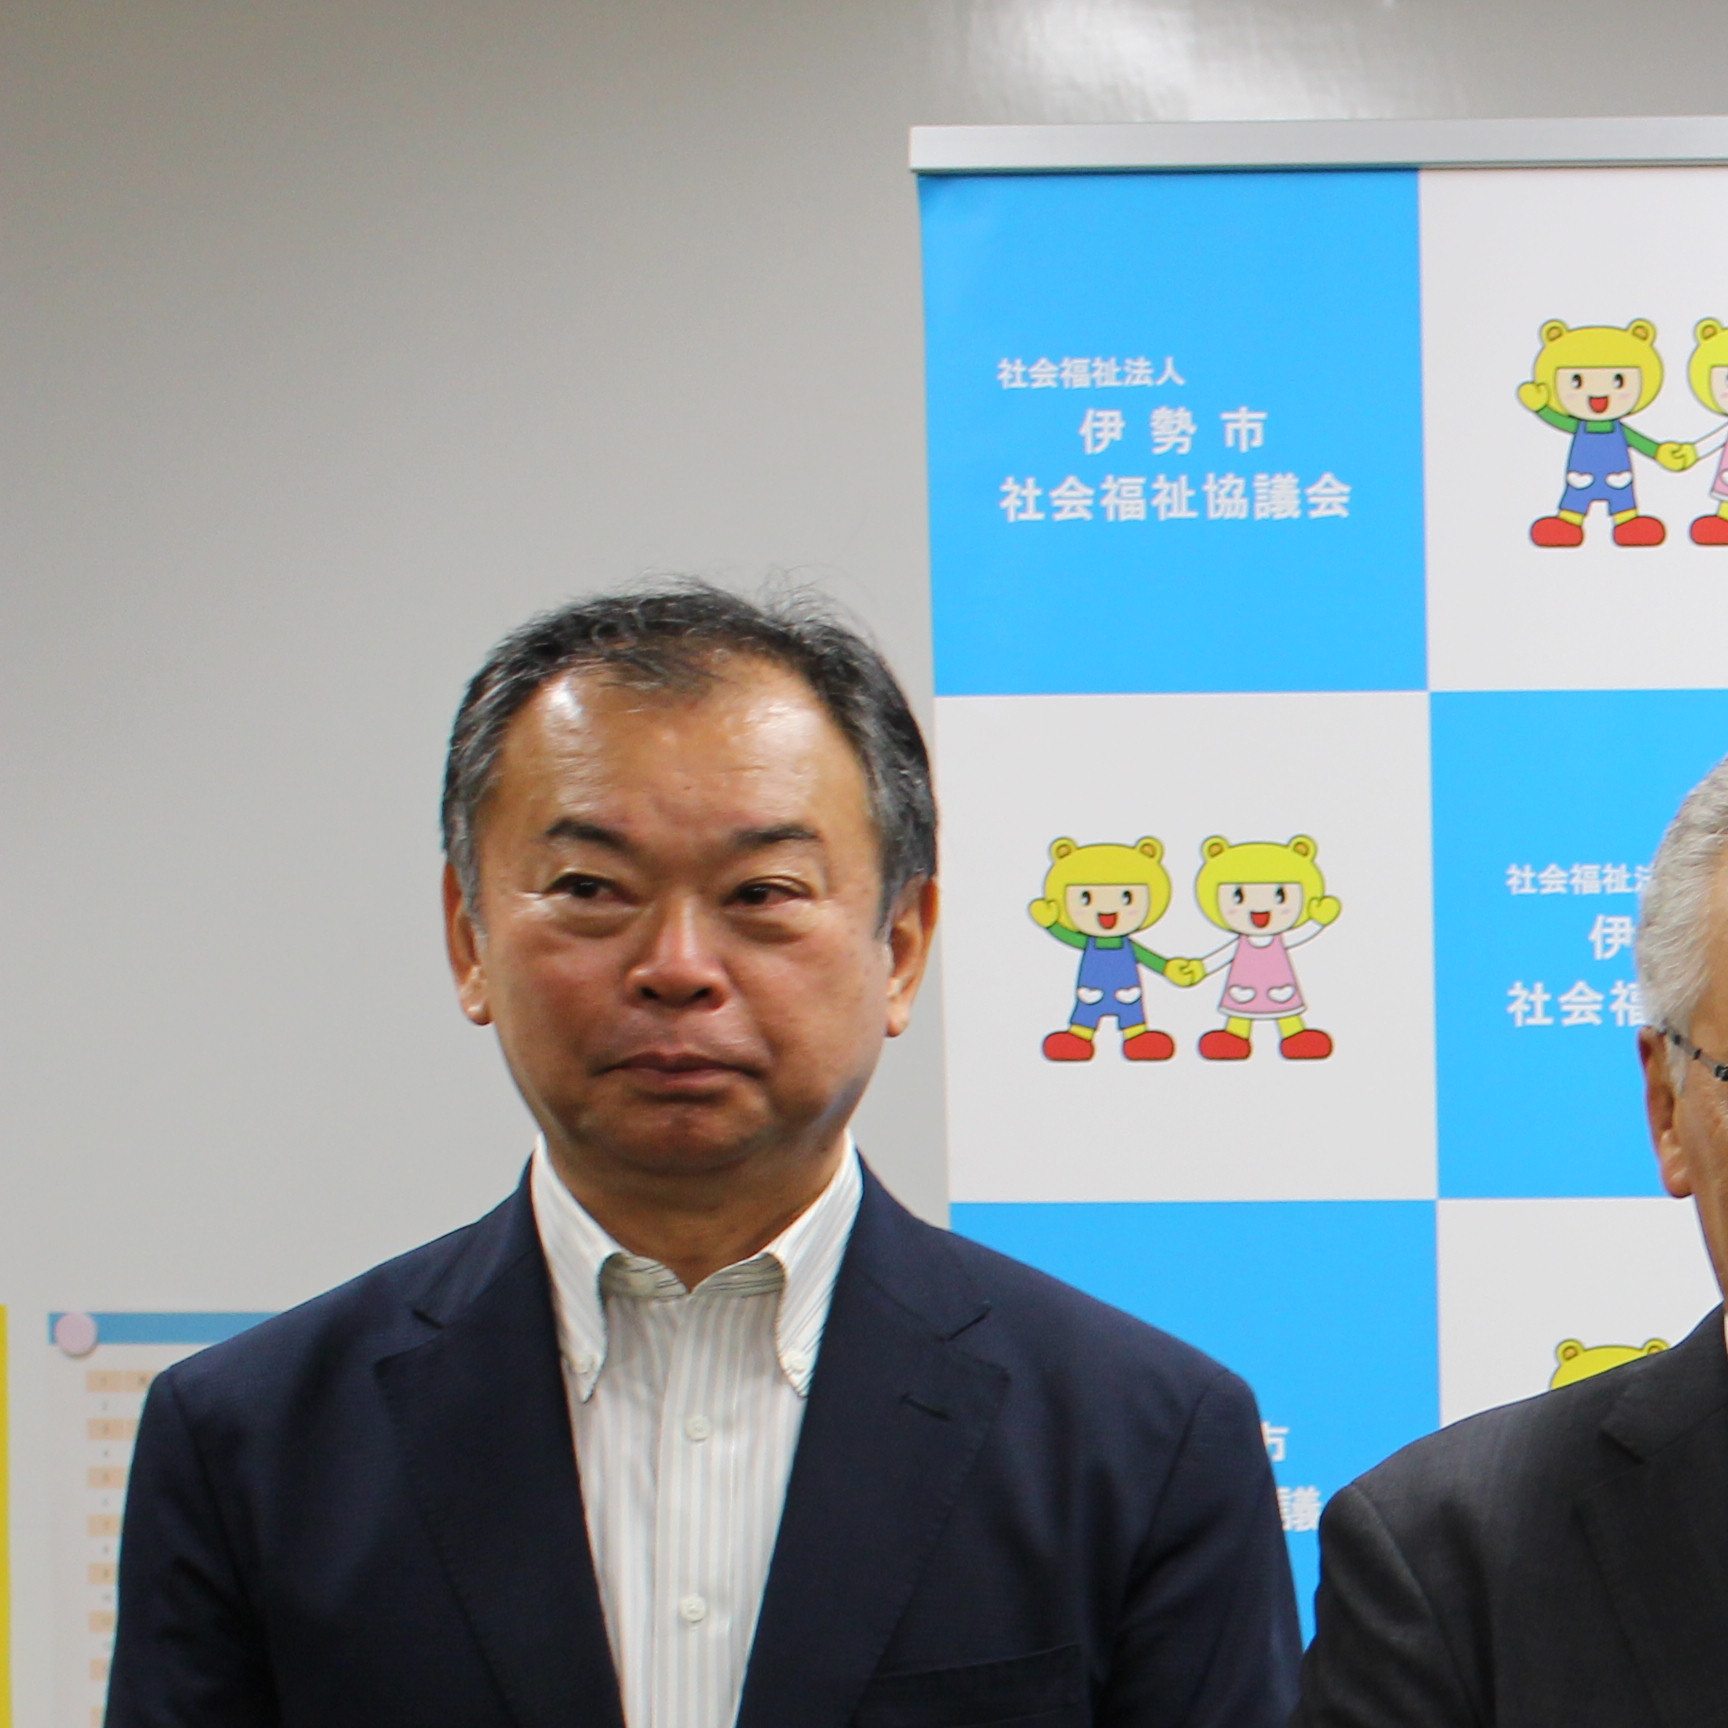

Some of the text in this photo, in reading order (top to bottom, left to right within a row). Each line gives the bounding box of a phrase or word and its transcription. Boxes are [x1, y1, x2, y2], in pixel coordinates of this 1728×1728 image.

[997, 357, 1186, 388] 社会福祉法人
[1078, 406, 1267, 455] 伊勢市
[1000, 472, 1351, 522] 社会福祉協議会
